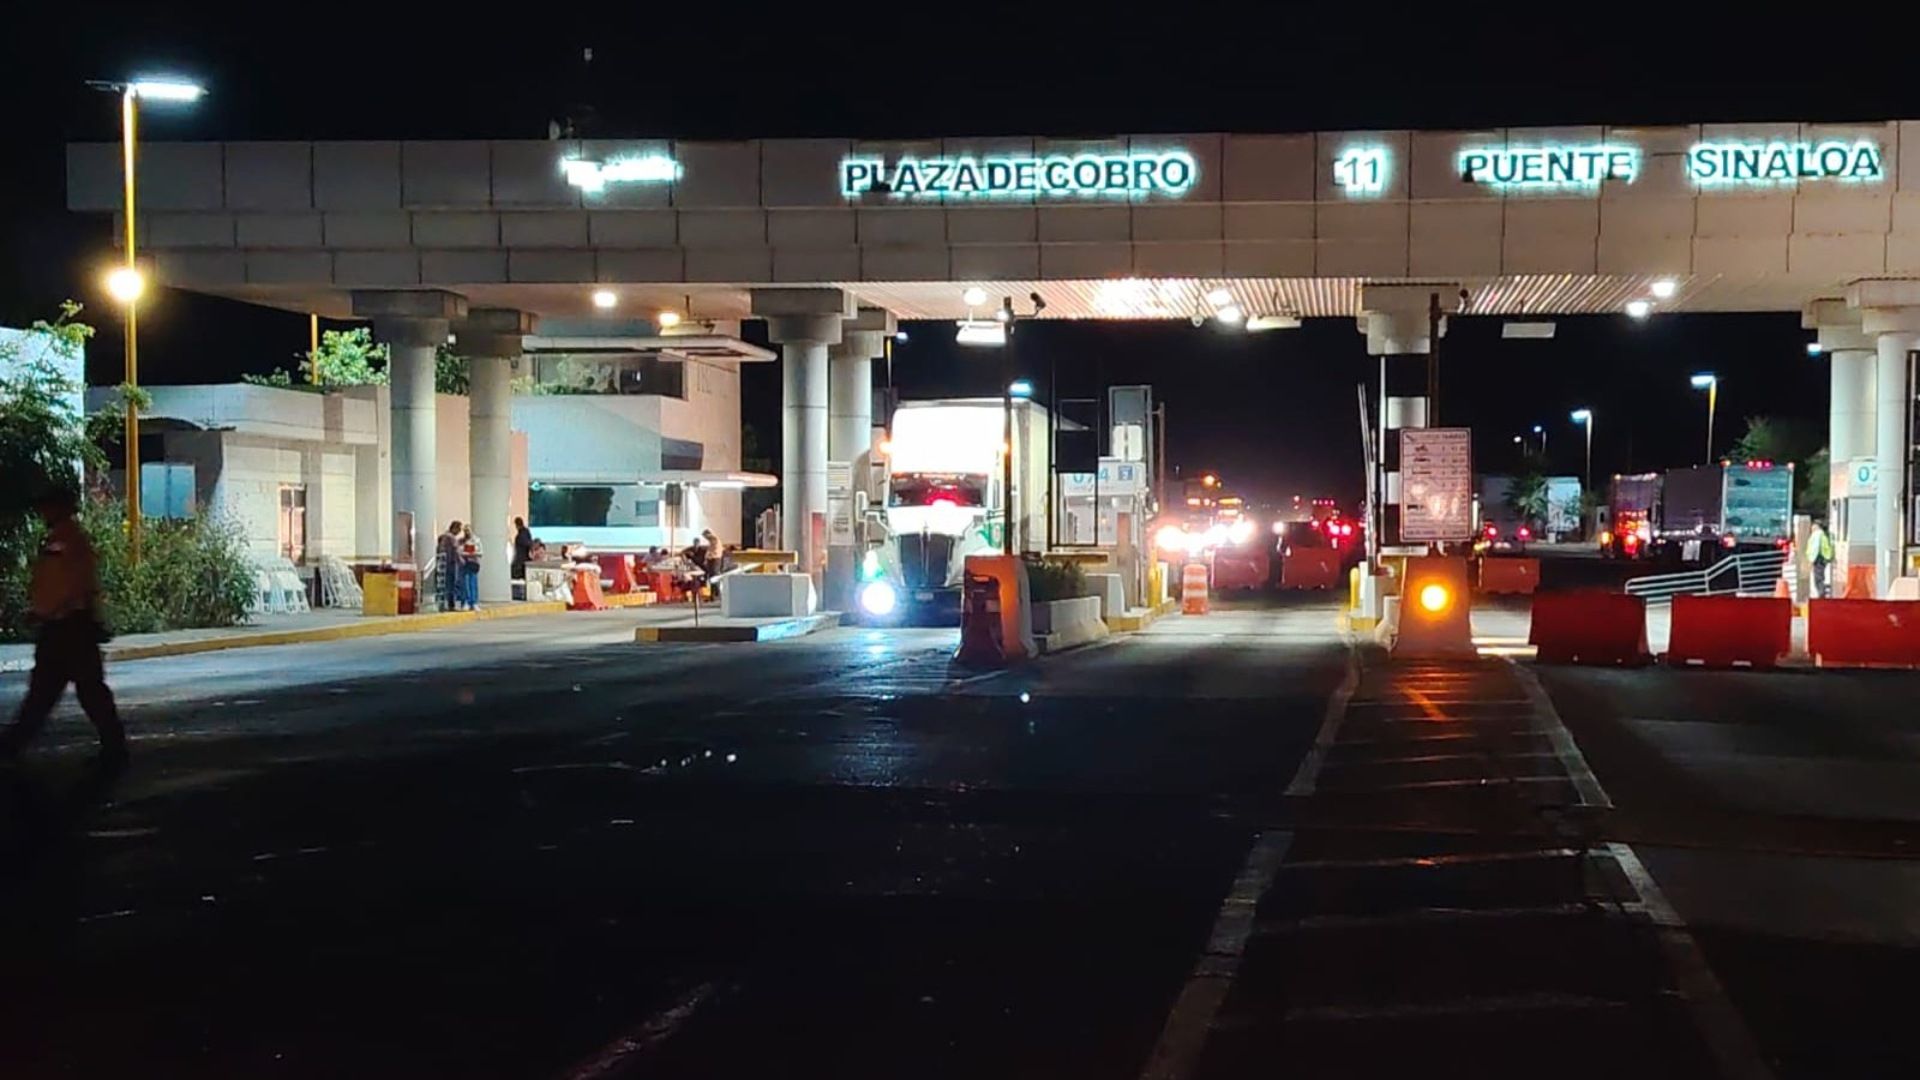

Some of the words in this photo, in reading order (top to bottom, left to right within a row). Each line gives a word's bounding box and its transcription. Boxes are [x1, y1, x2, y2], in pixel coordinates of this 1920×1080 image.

[847, 161, 980, 192] PLAZA
[987, 161, 1036, 191] DE
[1045, 157, 1190, 190] COBRO
[1344, 155, 1378, 185] 11
[1463, 151, 1632, 183] PUENTE
[1695, 147, 1879, 178] SINALOA
